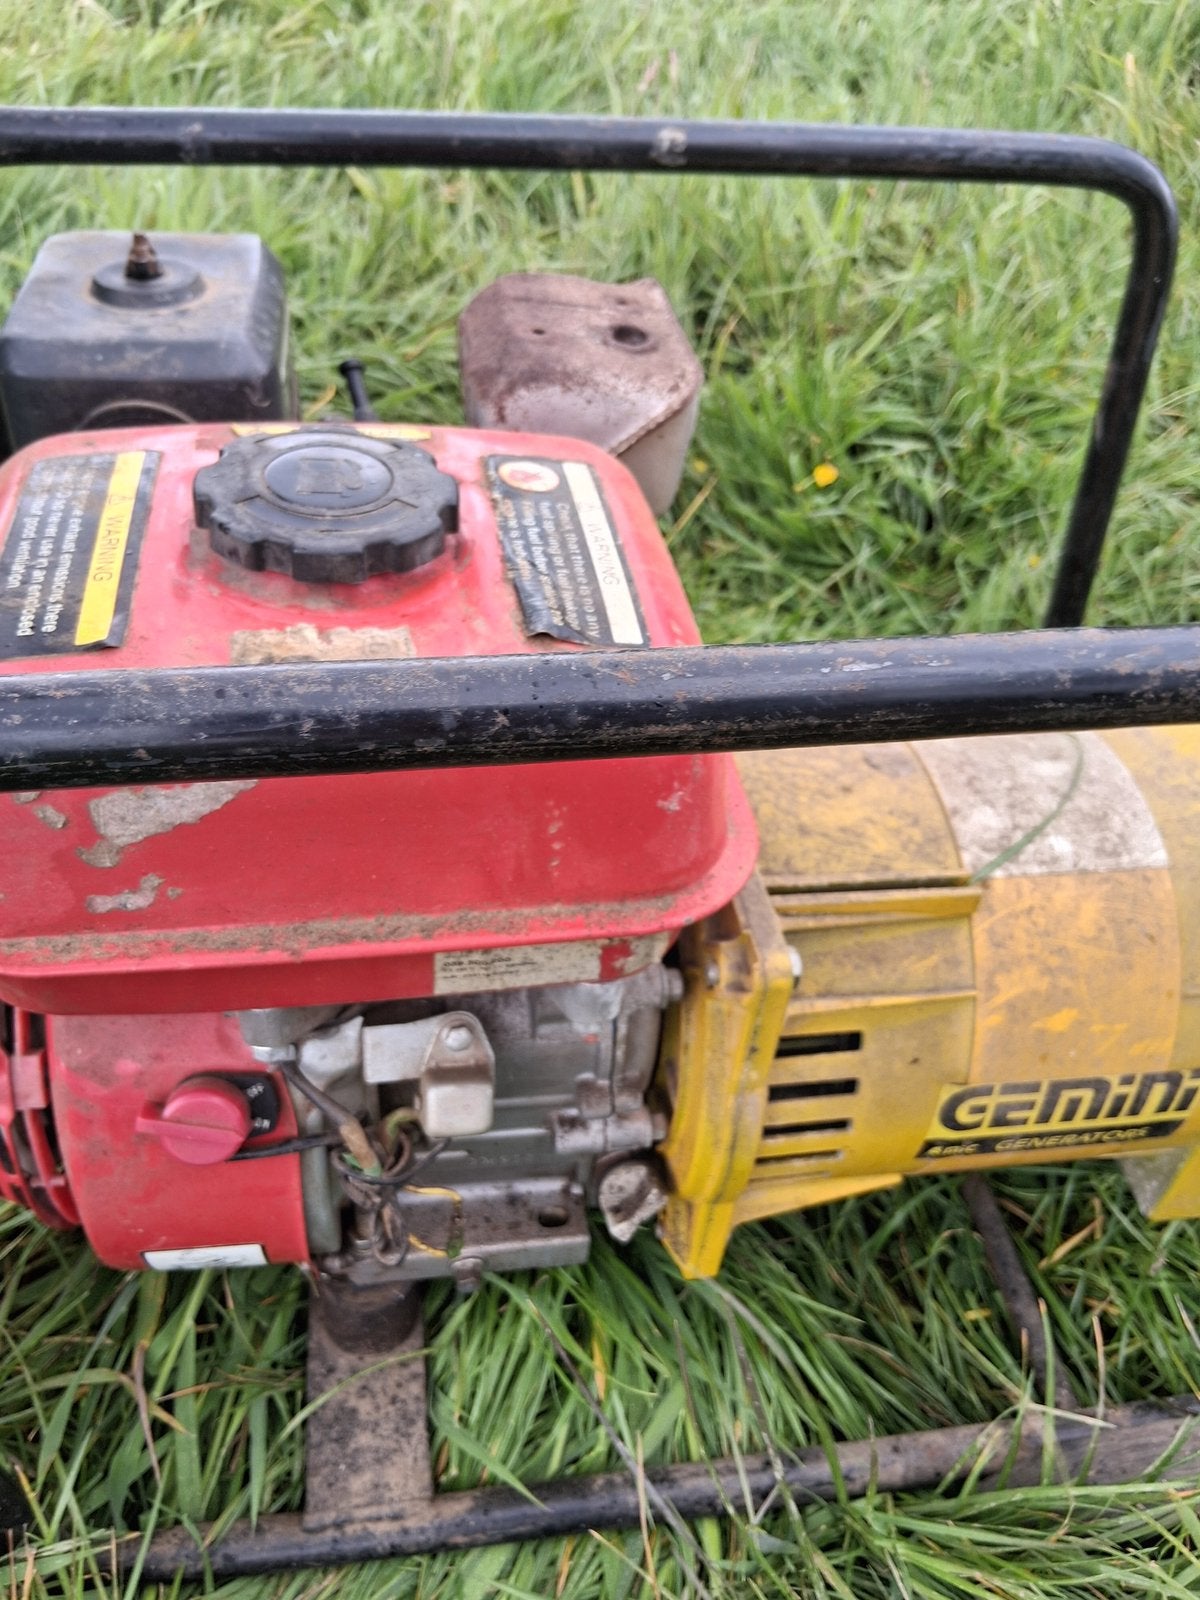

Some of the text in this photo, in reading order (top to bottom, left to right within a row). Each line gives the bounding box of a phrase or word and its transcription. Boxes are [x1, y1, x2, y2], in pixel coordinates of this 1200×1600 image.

[38, 538, 54, 557] use
[93, 515, 123, 582] WARNING
[564, 532, 580, 554] that
[31, 569, 47, 583] an
[48, 553, 73, 602] emissions
[571, 555, 588, 583] there
[16, 584, 42, 636] enclosed
[41, 603, 64, 632] there
[582, 598, 596, 613] no
[585, 614, 601, 638] any
[995, 1127, 1150, 1152] GENERATORS
